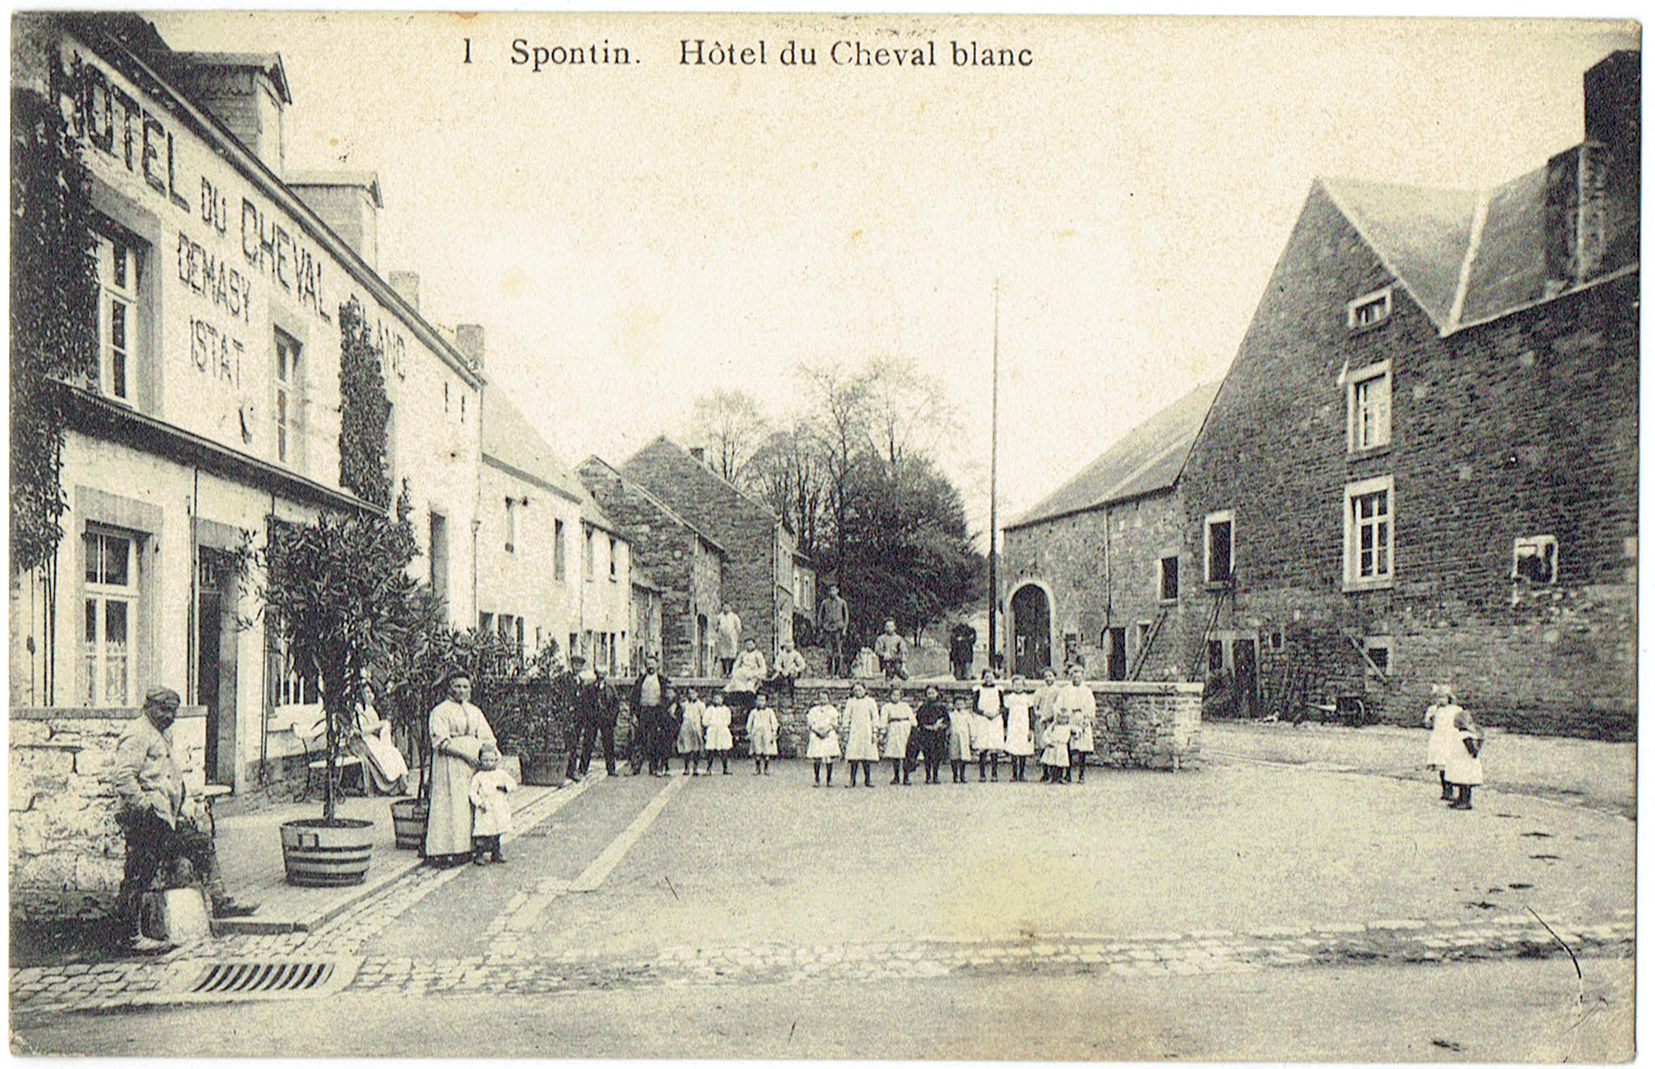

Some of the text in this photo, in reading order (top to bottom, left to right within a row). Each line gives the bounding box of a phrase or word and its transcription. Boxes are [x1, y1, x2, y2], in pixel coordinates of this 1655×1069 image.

[50, 45, 190, 214] HOTEL
[201, 175, 227, 239] DU
[241, 196, 331, 324] CHEVAL
